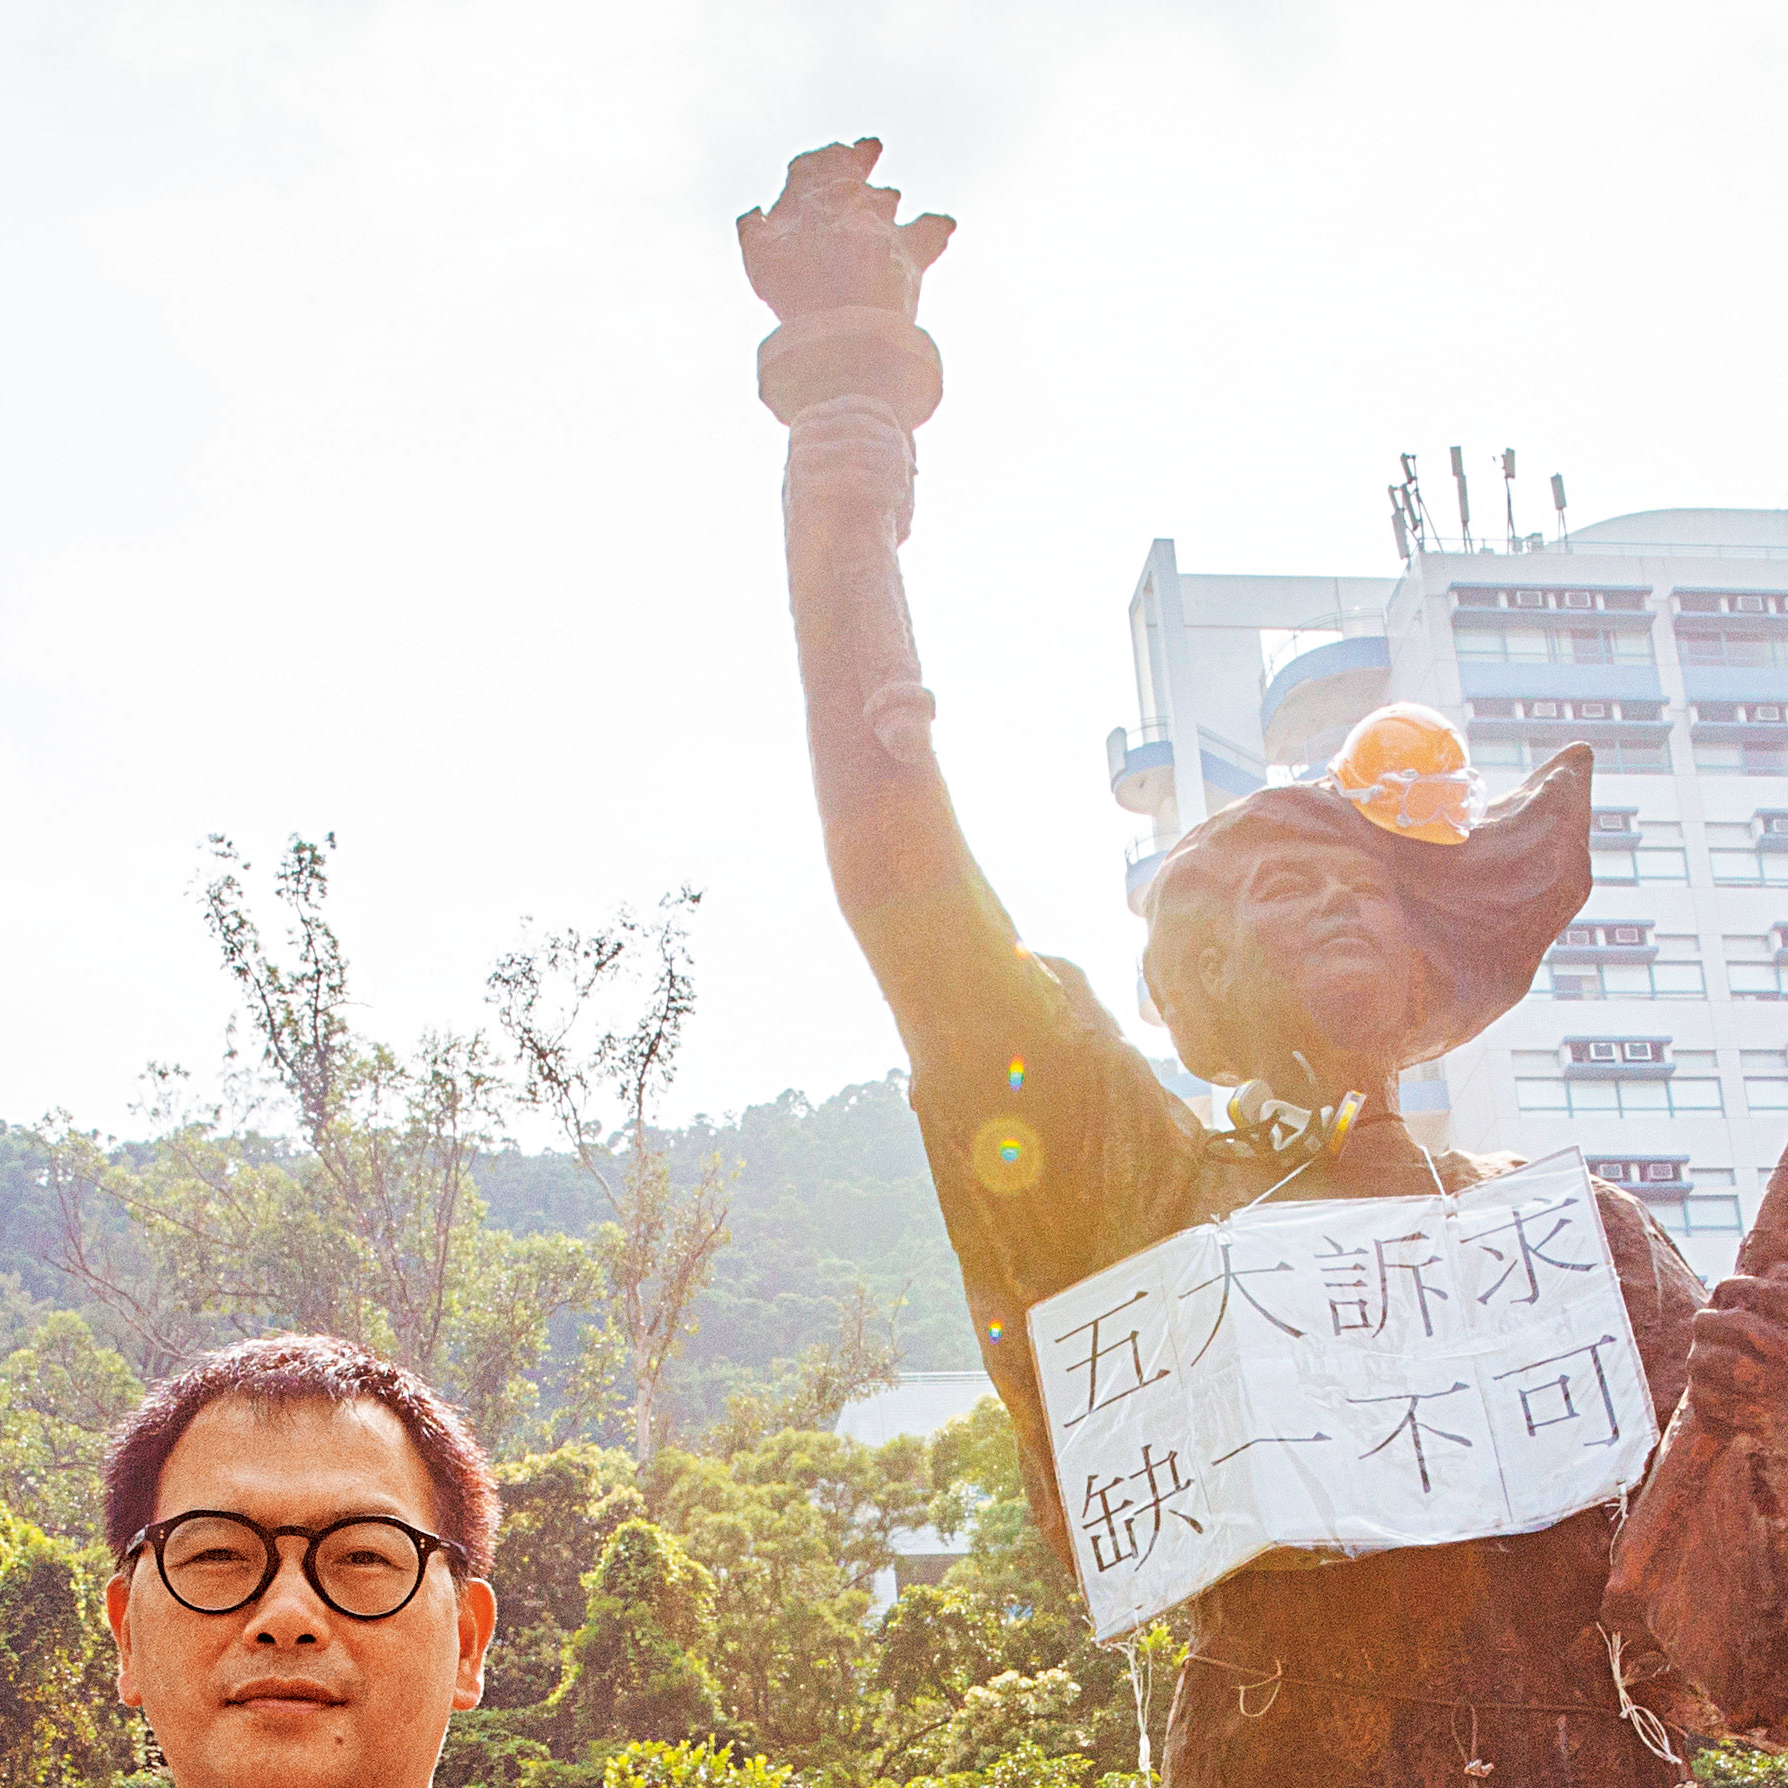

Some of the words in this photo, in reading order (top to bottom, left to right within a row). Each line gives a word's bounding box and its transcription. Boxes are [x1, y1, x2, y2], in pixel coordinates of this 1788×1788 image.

[1054, 1197, 1597, 1428] 五大訴求
[1081, 1334, 1622, 1573] 缺一不可
